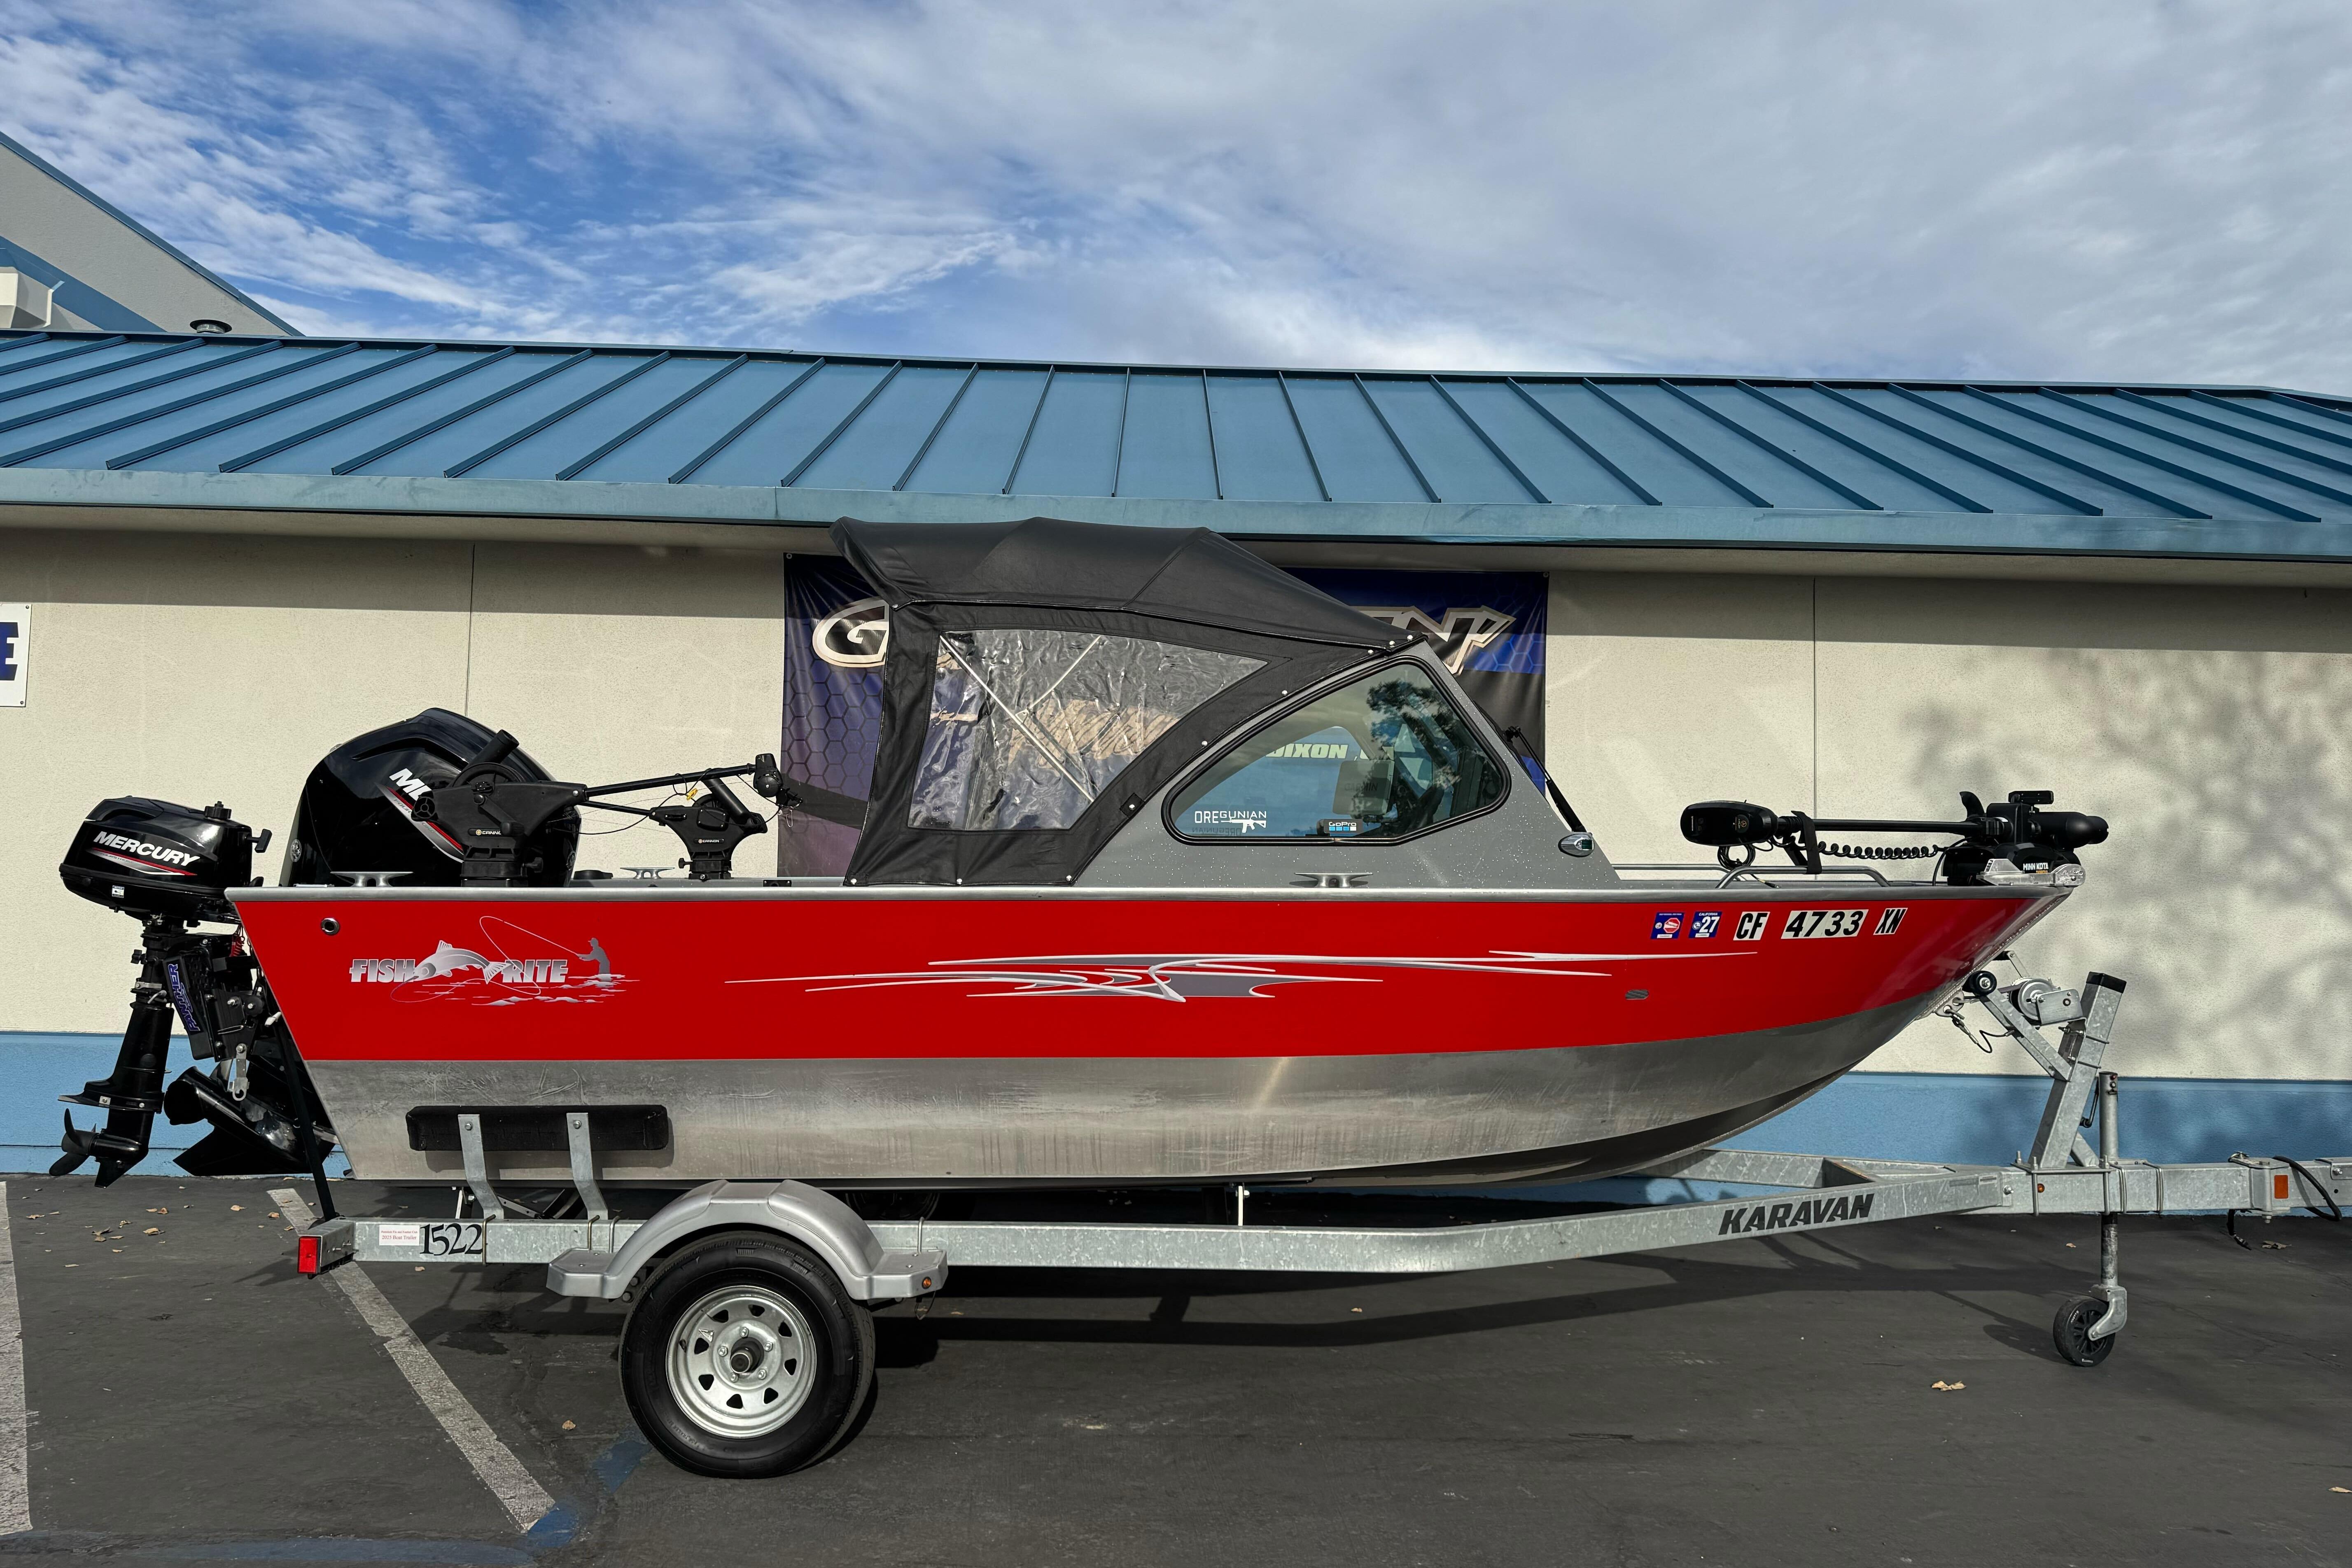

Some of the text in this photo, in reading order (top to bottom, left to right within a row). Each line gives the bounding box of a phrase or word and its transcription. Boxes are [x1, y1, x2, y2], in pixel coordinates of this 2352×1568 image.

[1195, 811, 1267, 824] OREGUNIAN
[93, 831, 200, 866] MERCURY
[1699, 916, 1720, 933] 27
[1736, 908, 1905, 939] CF 4733 XN
[349, 959, 568, 983] FISH RITE
[168, 964, 201, 1031] PANTHER
[1718, 1193, 1875, 1235] KARAVAN
[420, 1223, 483, 1255] 1522
